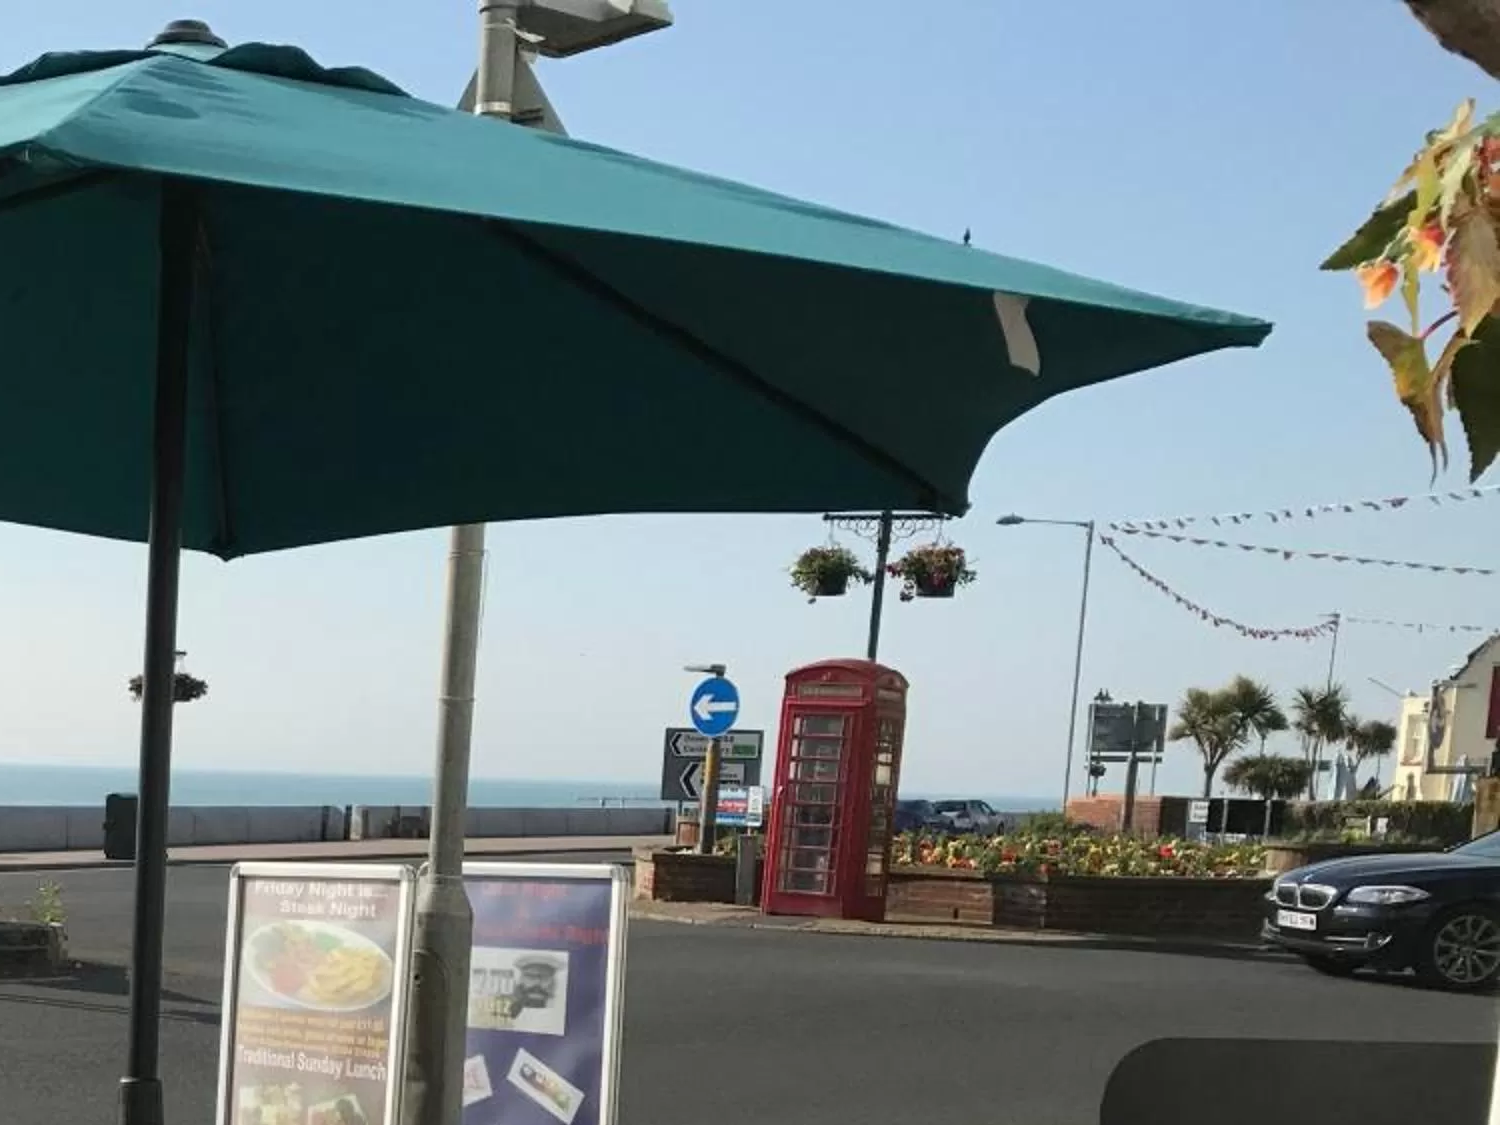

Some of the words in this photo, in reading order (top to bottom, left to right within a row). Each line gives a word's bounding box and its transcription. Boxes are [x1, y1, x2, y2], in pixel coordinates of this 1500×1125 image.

[255, 879, 304, 897] Friday
[308, 881, 356, 900] Night
[279, 899, 325, 915] Steak
[328, 901, 377, 918] Night
[237, 1044, 296, 1069] Traditional
[296, 1050, 344, 1080] Sunday
[345, 1058, 387, 1081] Lunch
